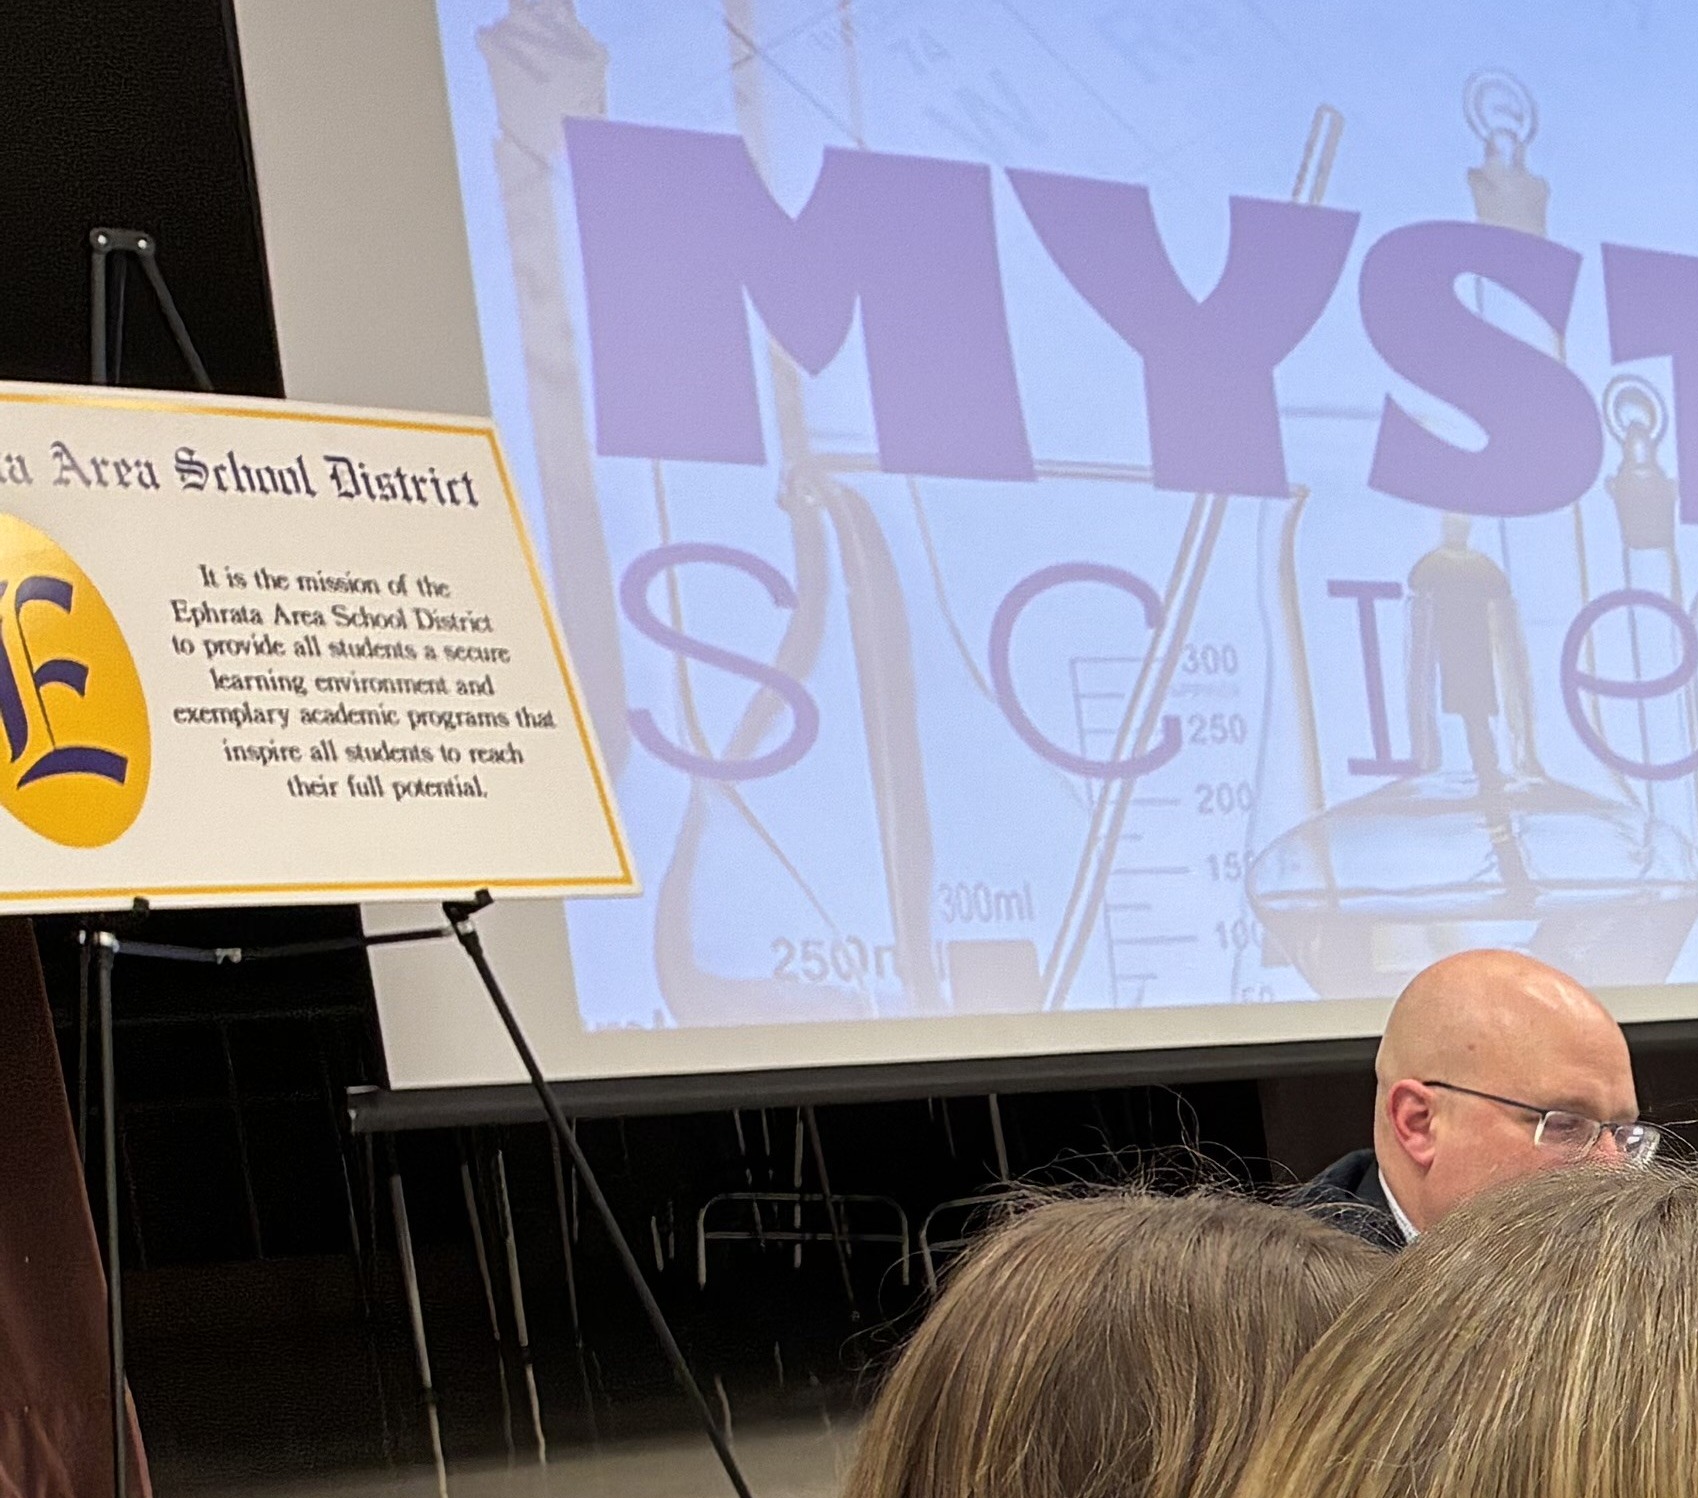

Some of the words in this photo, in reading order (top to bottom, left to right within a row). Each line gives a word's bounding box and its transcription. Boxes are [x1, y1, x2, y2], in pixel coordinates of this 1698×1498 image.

[51, 440, 161, 491] Area
[174, 446, 318, 498] School
[323, 454, 480, 507] District
[198, 563, 219, 588] It
[224, 565, 247, 589] is
[254, 566, 290, 591] the
[296, 569, 380, 594] mission
[387, 573, 408, 597] of
[416, 574, 451, 598] the
[170, 598, 264, 628] Ephrata
[273, 602, 327, 627] Area
[330, 603, 408, 631] School
[412, 606, 494, 633] District
[171, 634, 196, 656] to
[202, 632, 286, 660] provide
[293, 634, 321, 658] all
[328, 635, 417, 661] students
[424, 645, 437, 661] a
[443, 644, 511, 663] secure
[209, 666, 308, 697] learning
[314, 669, 450, 696] environment
[455, 673, 495, 697] and
[172, 700, 290, 729] exemplary
[300, 701, 400, 727] academic
[407, 708, 510, 731] programs
[515, 706, 557, 729] that
[1187, 714, 1247, 746] 250
[222, 737, 303, 767] inspire
[310, 739, 339, 762] all
[344, 739, 434, 765] students
[440, 743, 462, 765] to
[468, 741, 525, 765] reach
[286, 773, 339, 798] their
[346, 773, 385, 798] full
[391, 773, 488, 803] potential.
[1195, 782, 1255, 815] 200
